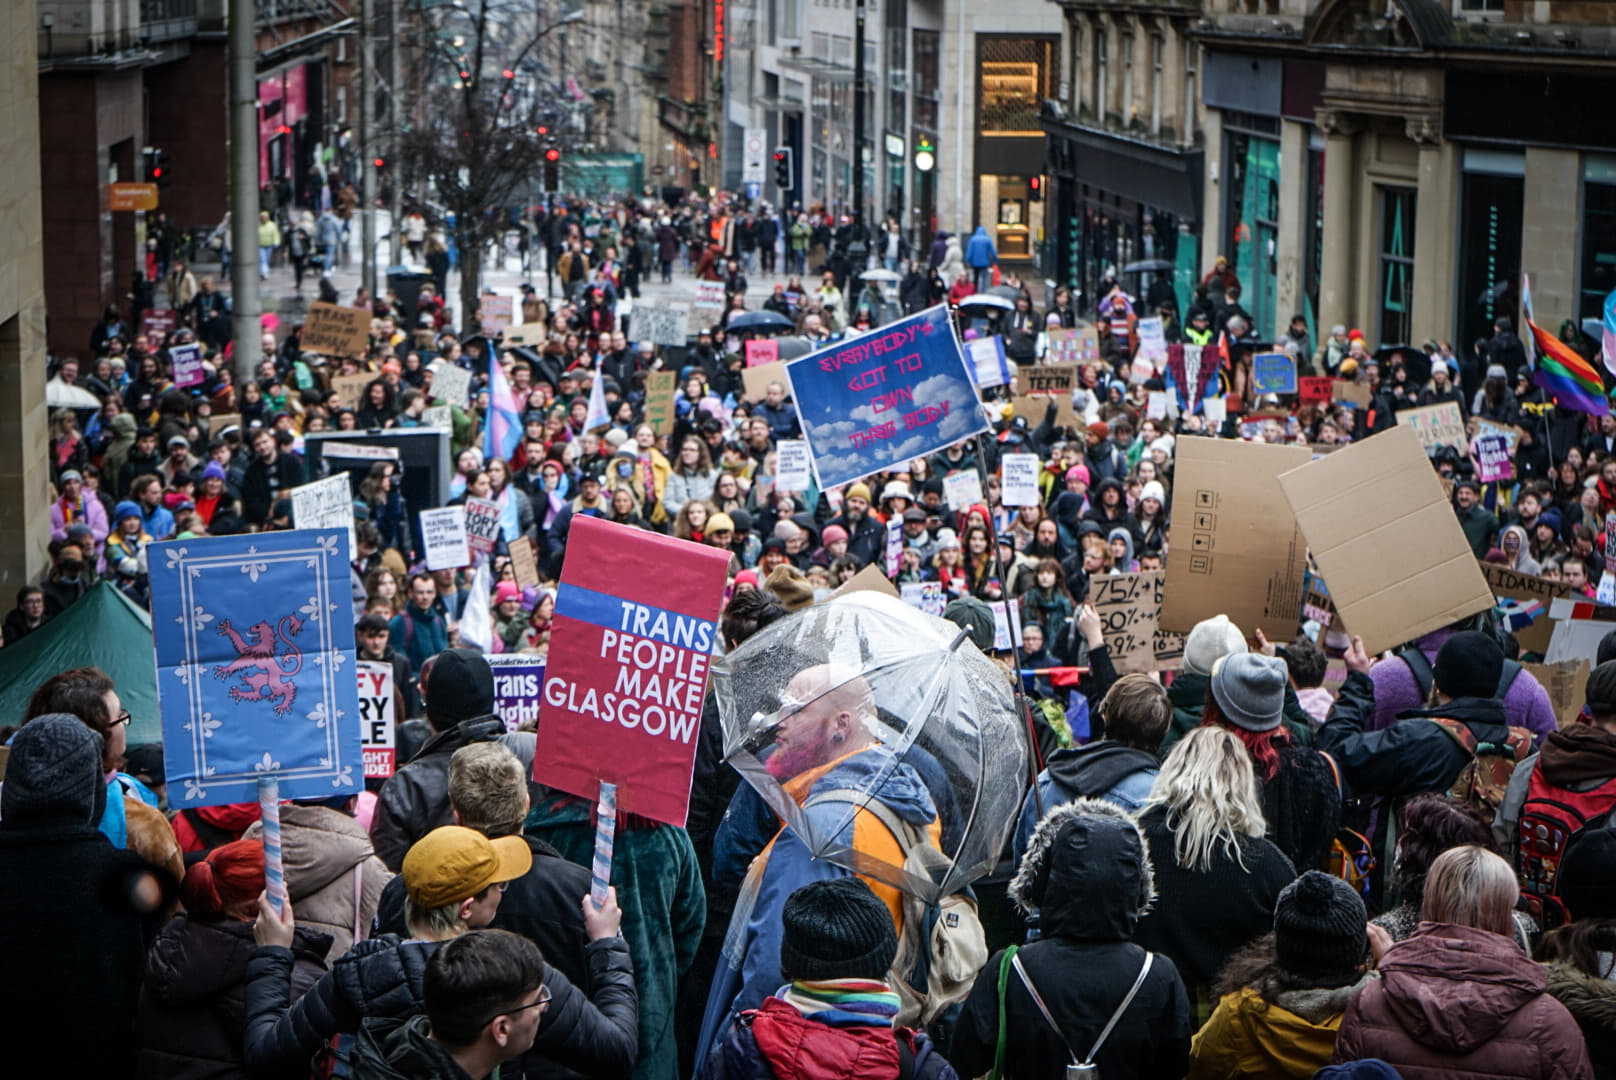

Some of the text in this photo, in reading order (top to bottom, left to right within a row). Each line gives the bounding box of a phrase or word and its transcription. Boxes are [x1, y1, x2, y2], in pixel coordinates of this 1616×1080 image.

[848, 353, 923, 392] GOT TO
[871, 385, 914, 414] OWN
[902, 400, 950, 431] BODY
[465, 511, 500, 531] TORY
[468, 500, 501, 518] DEFY
[1094, 576, 1141, 603] 75%
[621, 600, 714, 657] TRANS
[600, 629, 708, 685] PEOPLE
[614, 665, 704, 716] MAKE
[545, 677, 698, 744] GLASGOW
